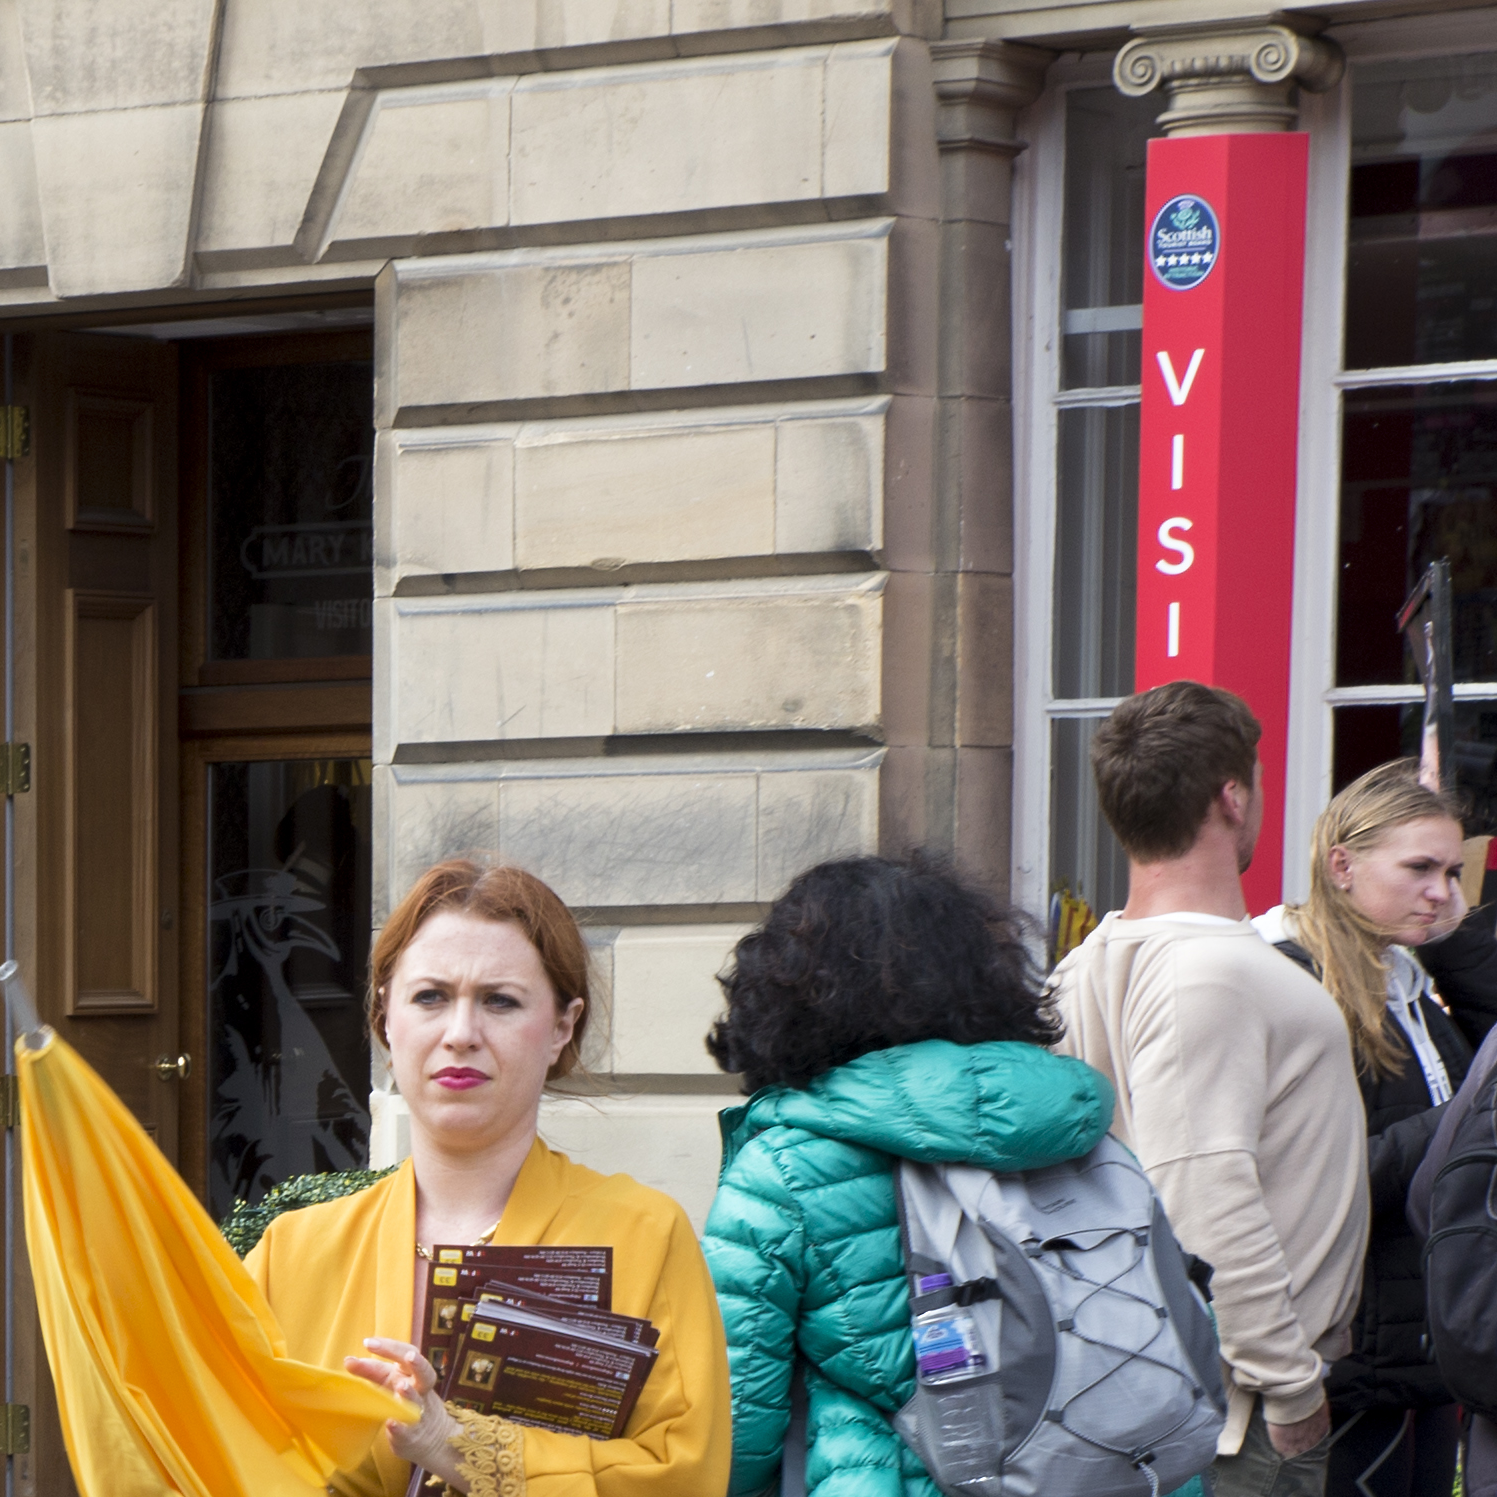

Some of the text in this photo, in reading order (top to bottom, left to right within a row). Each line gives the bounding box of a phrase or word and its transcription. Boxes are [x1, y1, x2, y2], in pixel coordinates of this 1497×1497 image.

[1157, 226, 1212, 242] Scottish
[1156, 348, 1205, 660] VISI
[262, 533, 346, 567] MARY
[314, 598, 372, 630] VISITO
